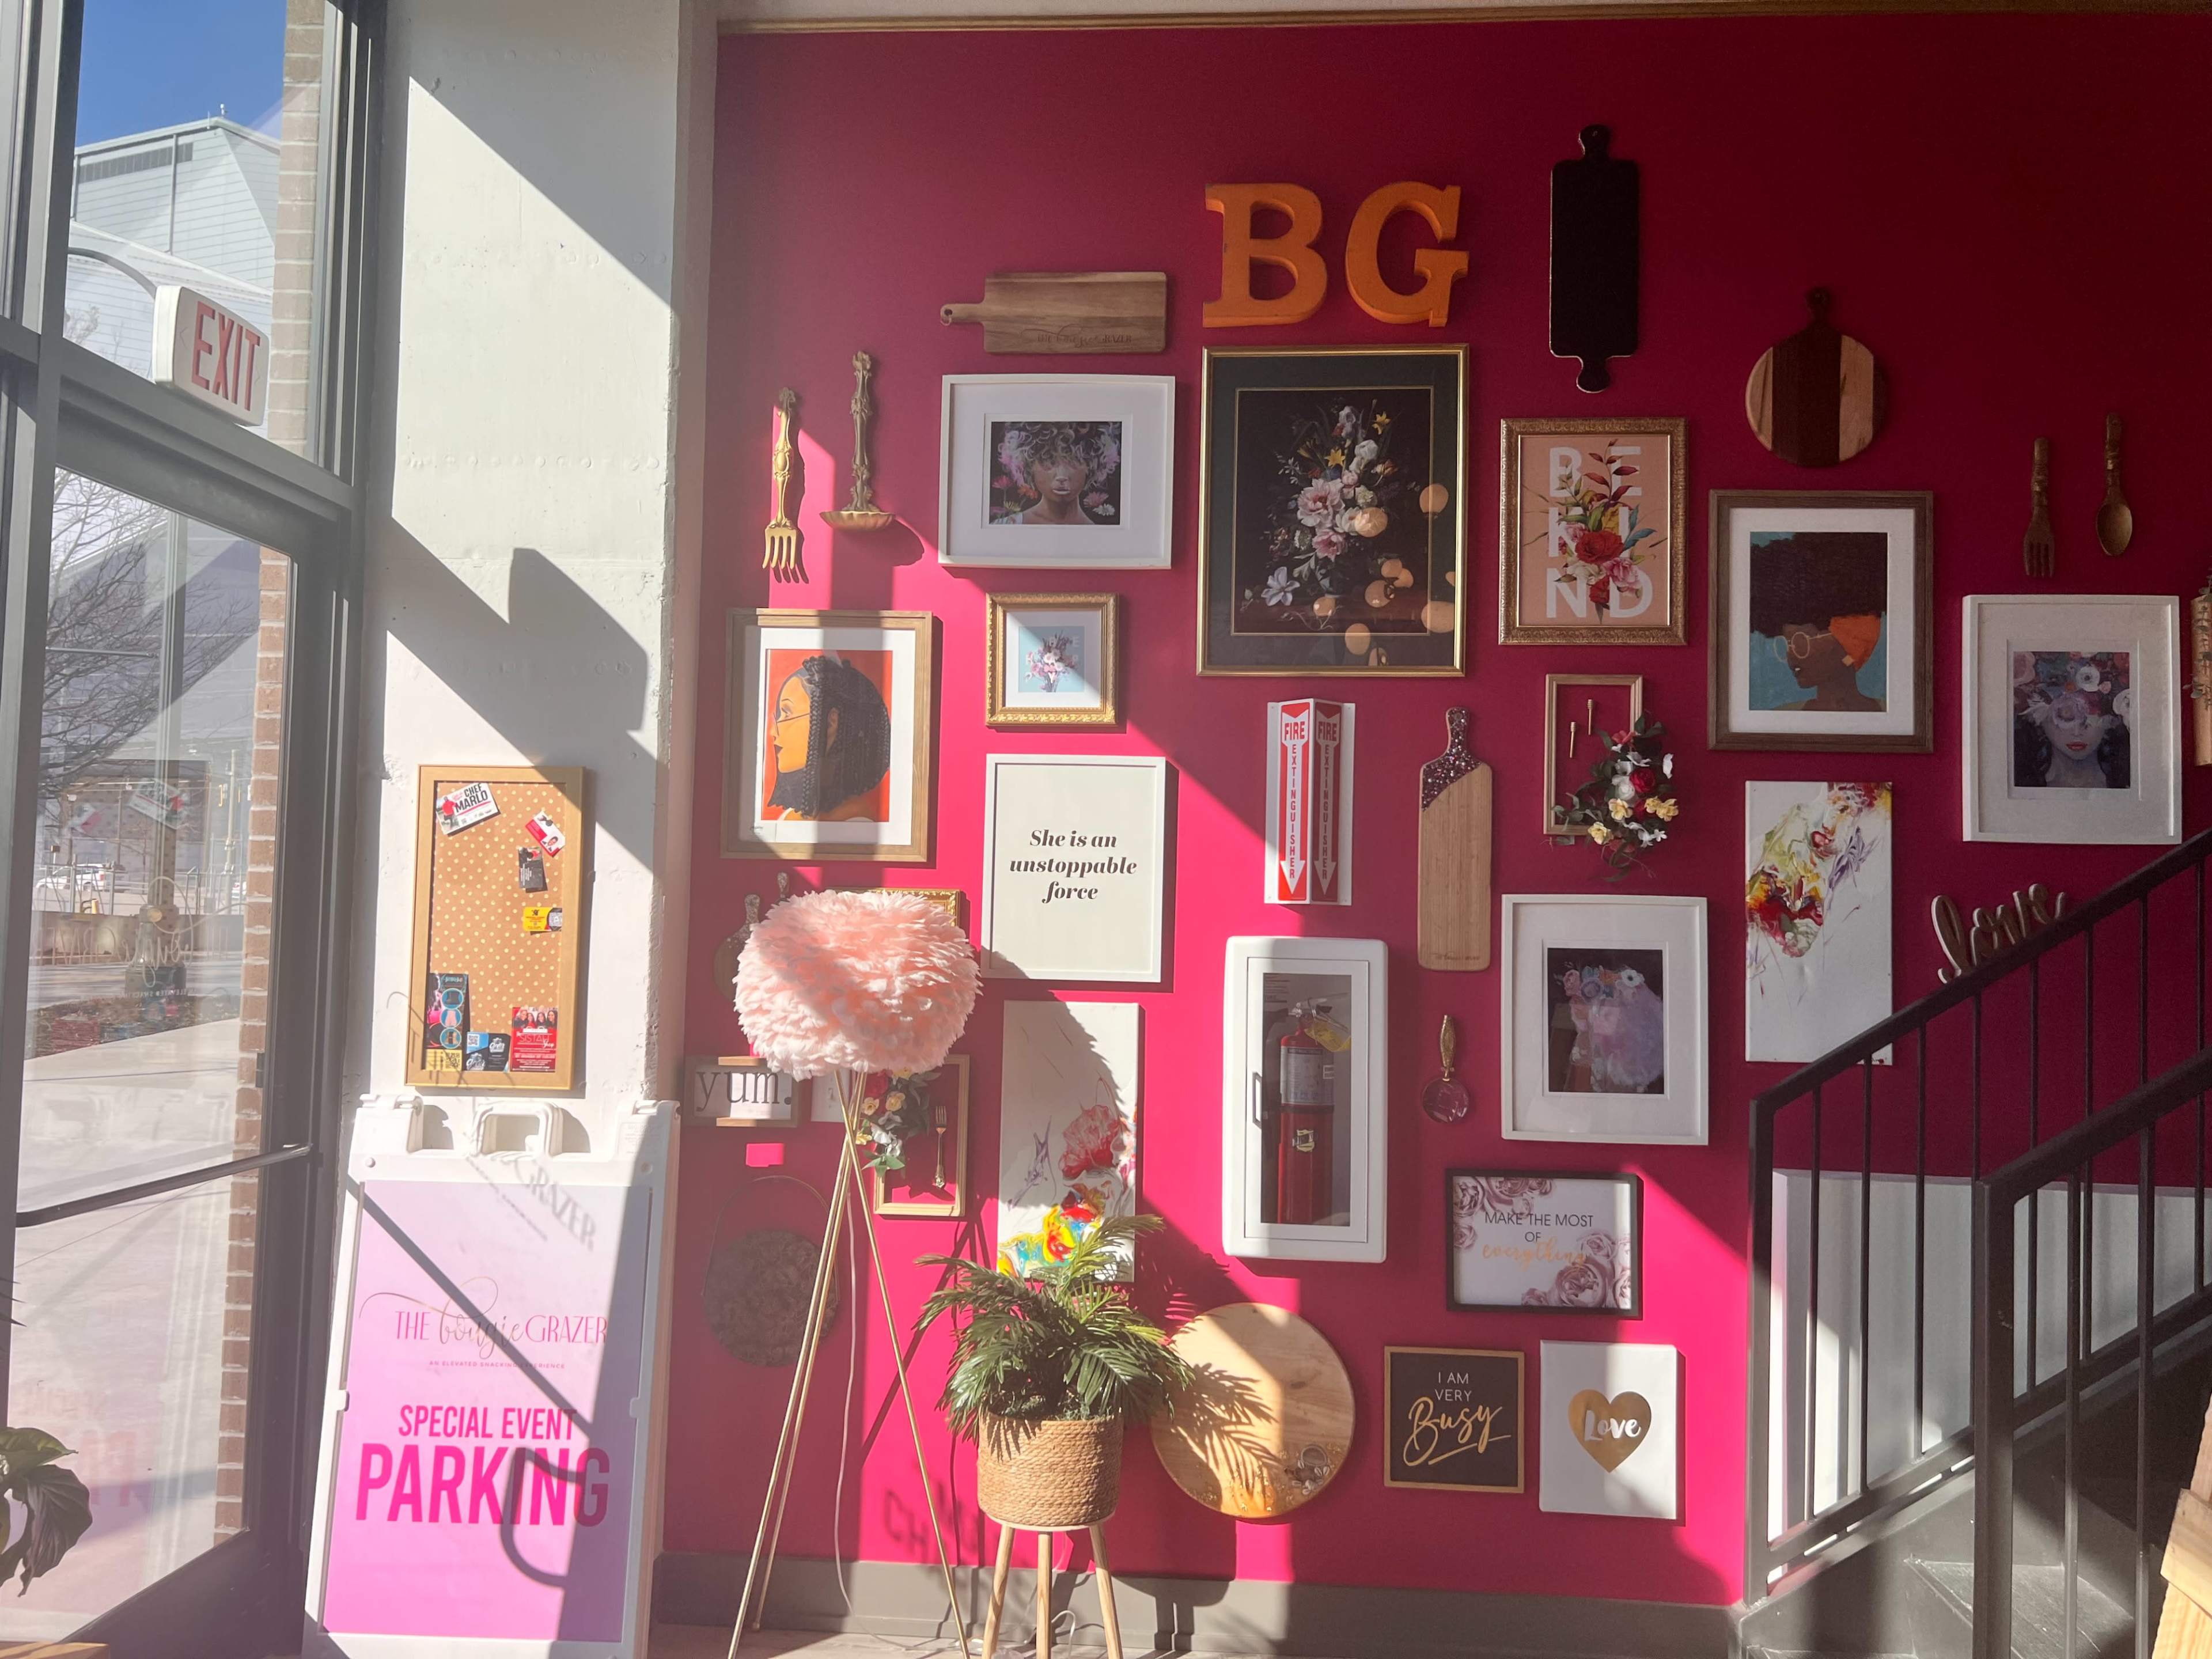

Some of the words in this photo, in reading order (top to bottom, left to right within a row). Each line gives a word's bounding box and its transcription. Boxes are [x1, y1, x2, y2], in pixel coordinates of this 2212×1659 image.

[1203, 181, 1469, 328] BG
[1101, 334, 1132, 343] RAZER
[192, 301, 260, 411] EXIT
[1548, 446, 1642, 498] BE
[1546, 567, 1653, 618] ND
[1284, 721, 1305, 741] FIRE
[1318, 721, 1337, 741] FIRE
[454, 790, 488, 813] MARLO
[464, 783, 482, 797] CHEF
[1289, 744, 1297, 879] EXTINGUISHER
[1321, 744, 1330, 880] EXTINGUISHER
[1029, 829, 1066, 847] She
[1070, 830, 1088, 847] is
[1091, 835, 1118, 848] an
[1009, 857, 1137, 878] unstoppable
[1041, 881, 1099, 904] force
[1931, 883, 2065, 984] love
[696, 1069, 792, 1112] yum.
[1484, 1211, 1522, 1225] MAKE
[1528, 1213, 1551, 1226] THE
[1555, 1214, 1593, 1228] MOST
[1524, 1231, 1541, 1243] OF
[1481, 1237, 1587, 1274] everything
[395, 1310, 431, 1340] THE
[525, 1314, 608, 1344] GRAZER
[1438, 1371, 1441, 1384] I
[1446, 1372, 1469, 1385] AM
[1434, 1388, 1473, 1402] VERY
[398, 1404, 494, 1438] SPECIAL
[501, 1408, 577, 1440] EVENT
[1403, 1396, 1503, 1467] Busy
[1584, 1410, 1641, 1441] Love
[355, 1442, 610, 1527] PARKING
